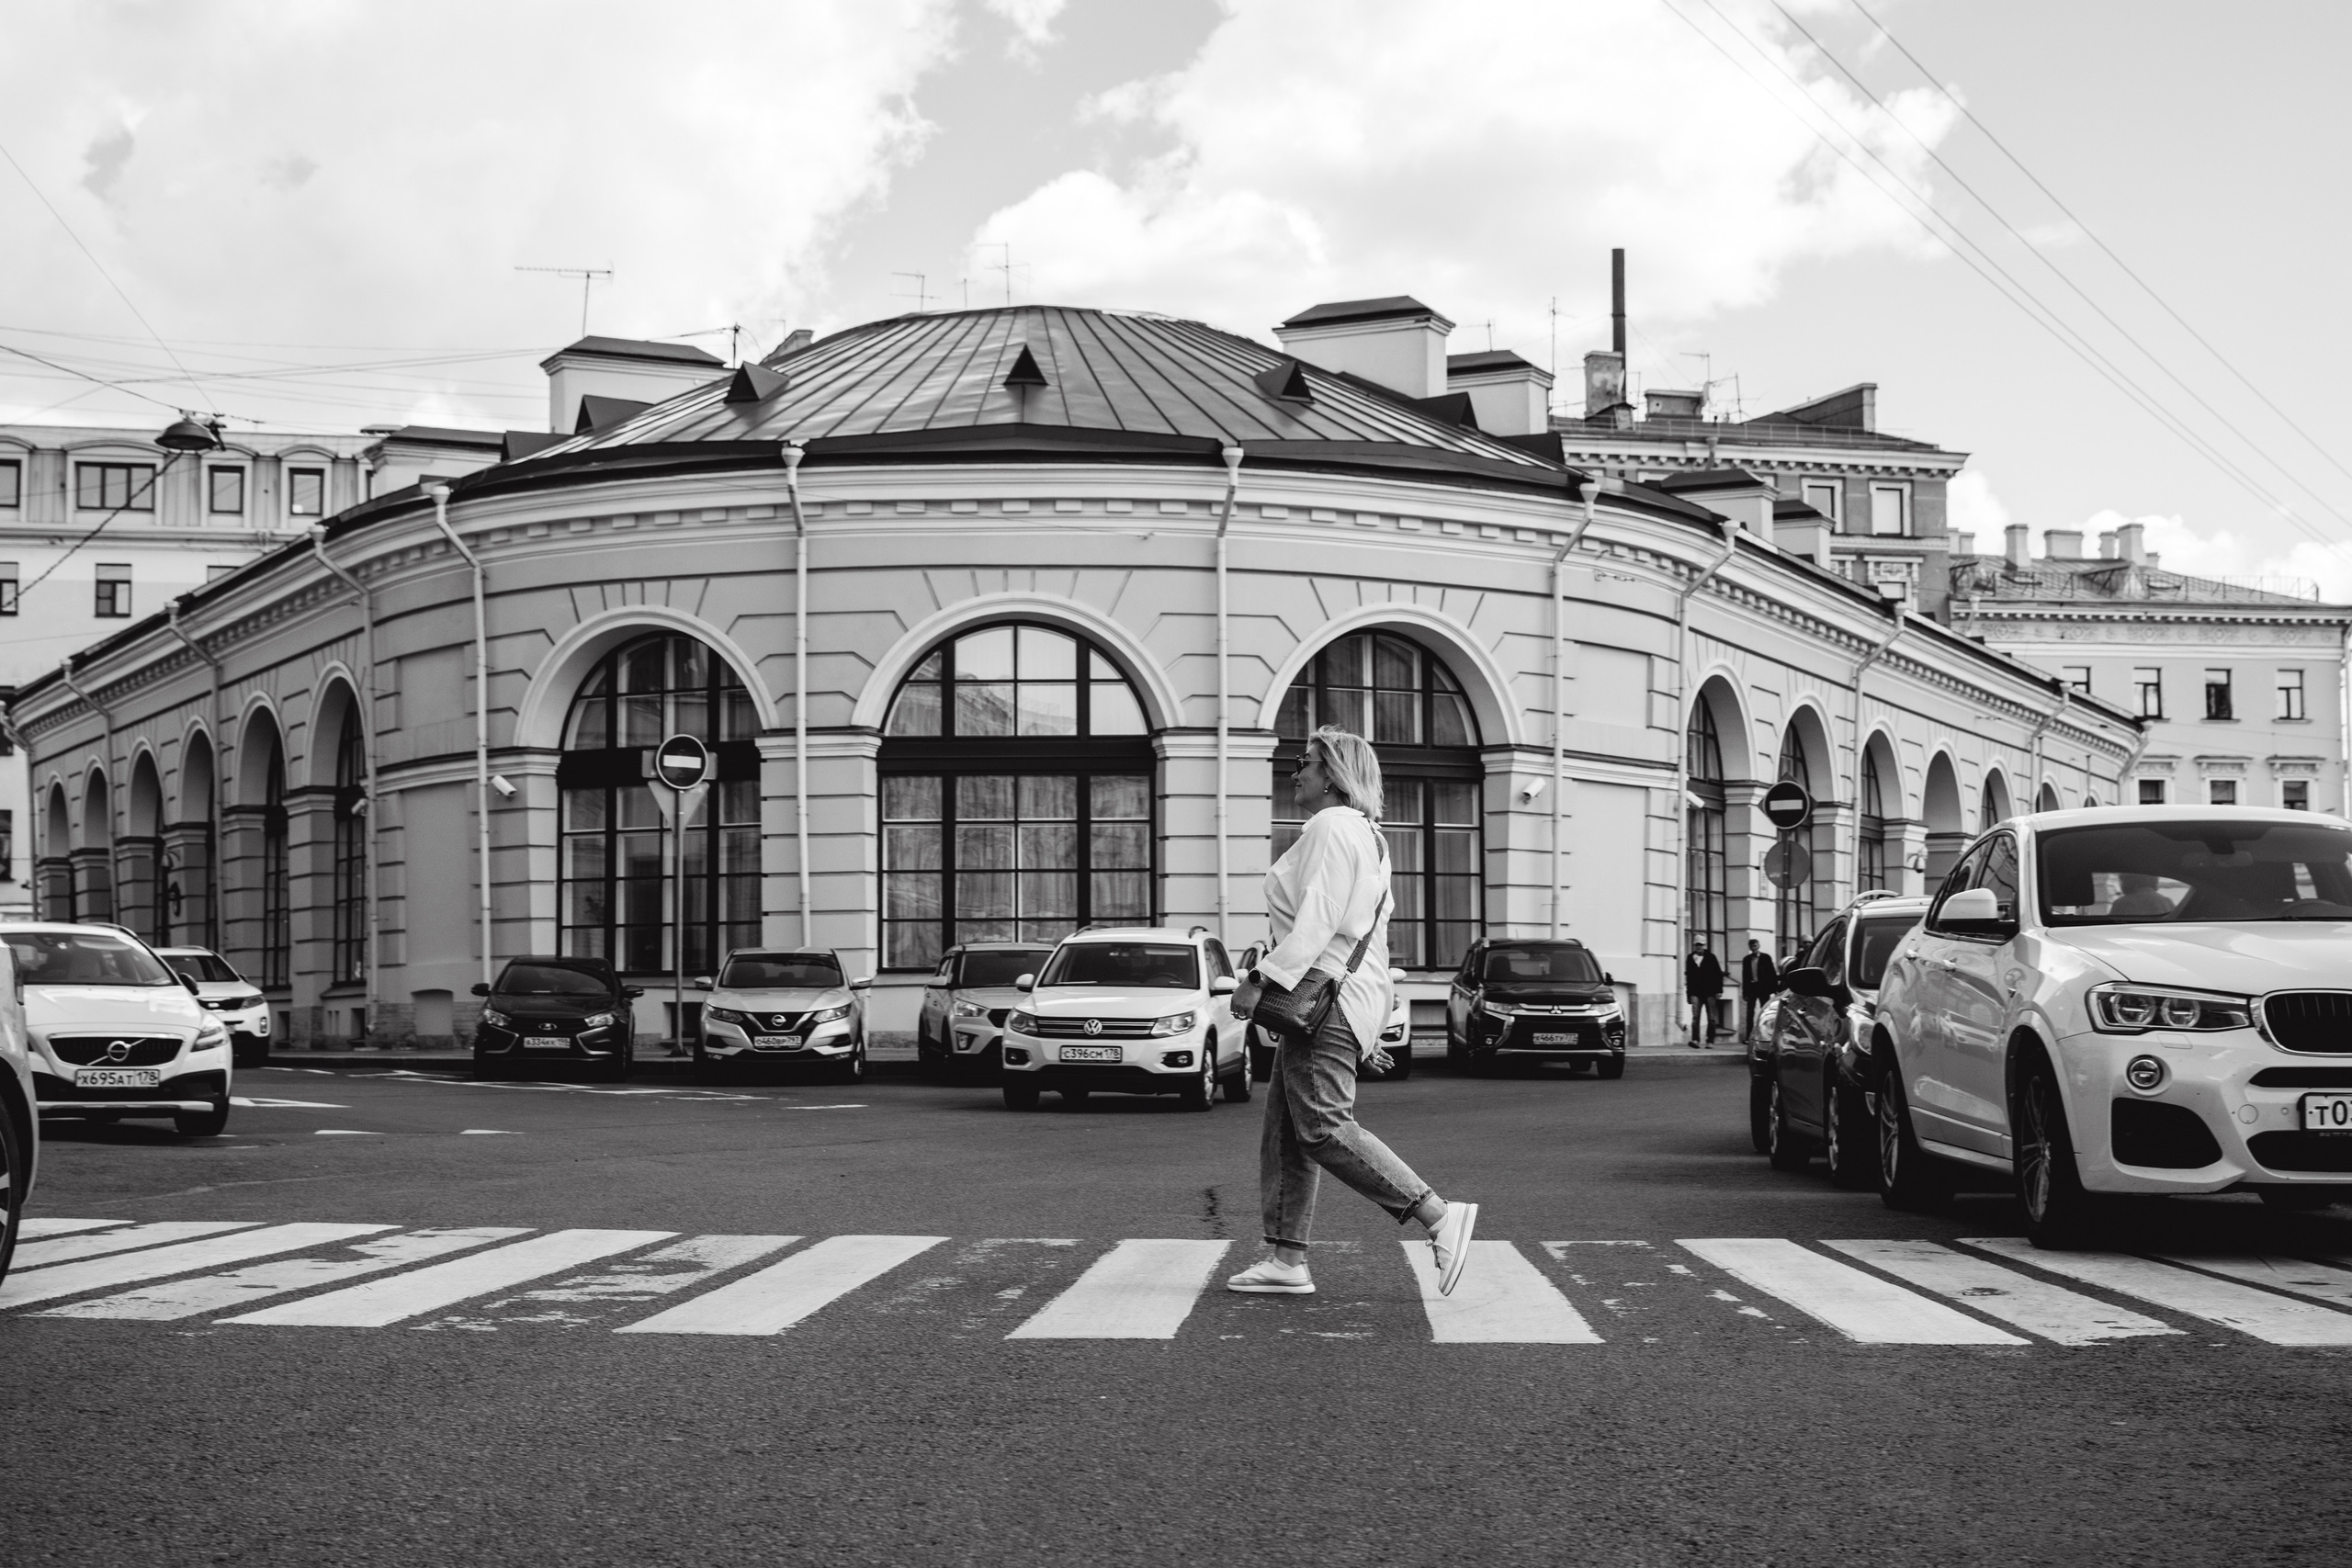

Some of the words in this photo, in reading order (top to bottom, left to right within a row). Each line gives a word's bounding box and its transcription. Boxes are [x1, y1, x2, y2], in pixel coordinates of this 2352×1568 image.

[1064, 1048, 1102, 1058] С396СМ
[81, 1072, 133, 1085] Х695АТ
[137, 1071, 157, 1081] 178
[2314, 1100, 2352, 1126] Т0
